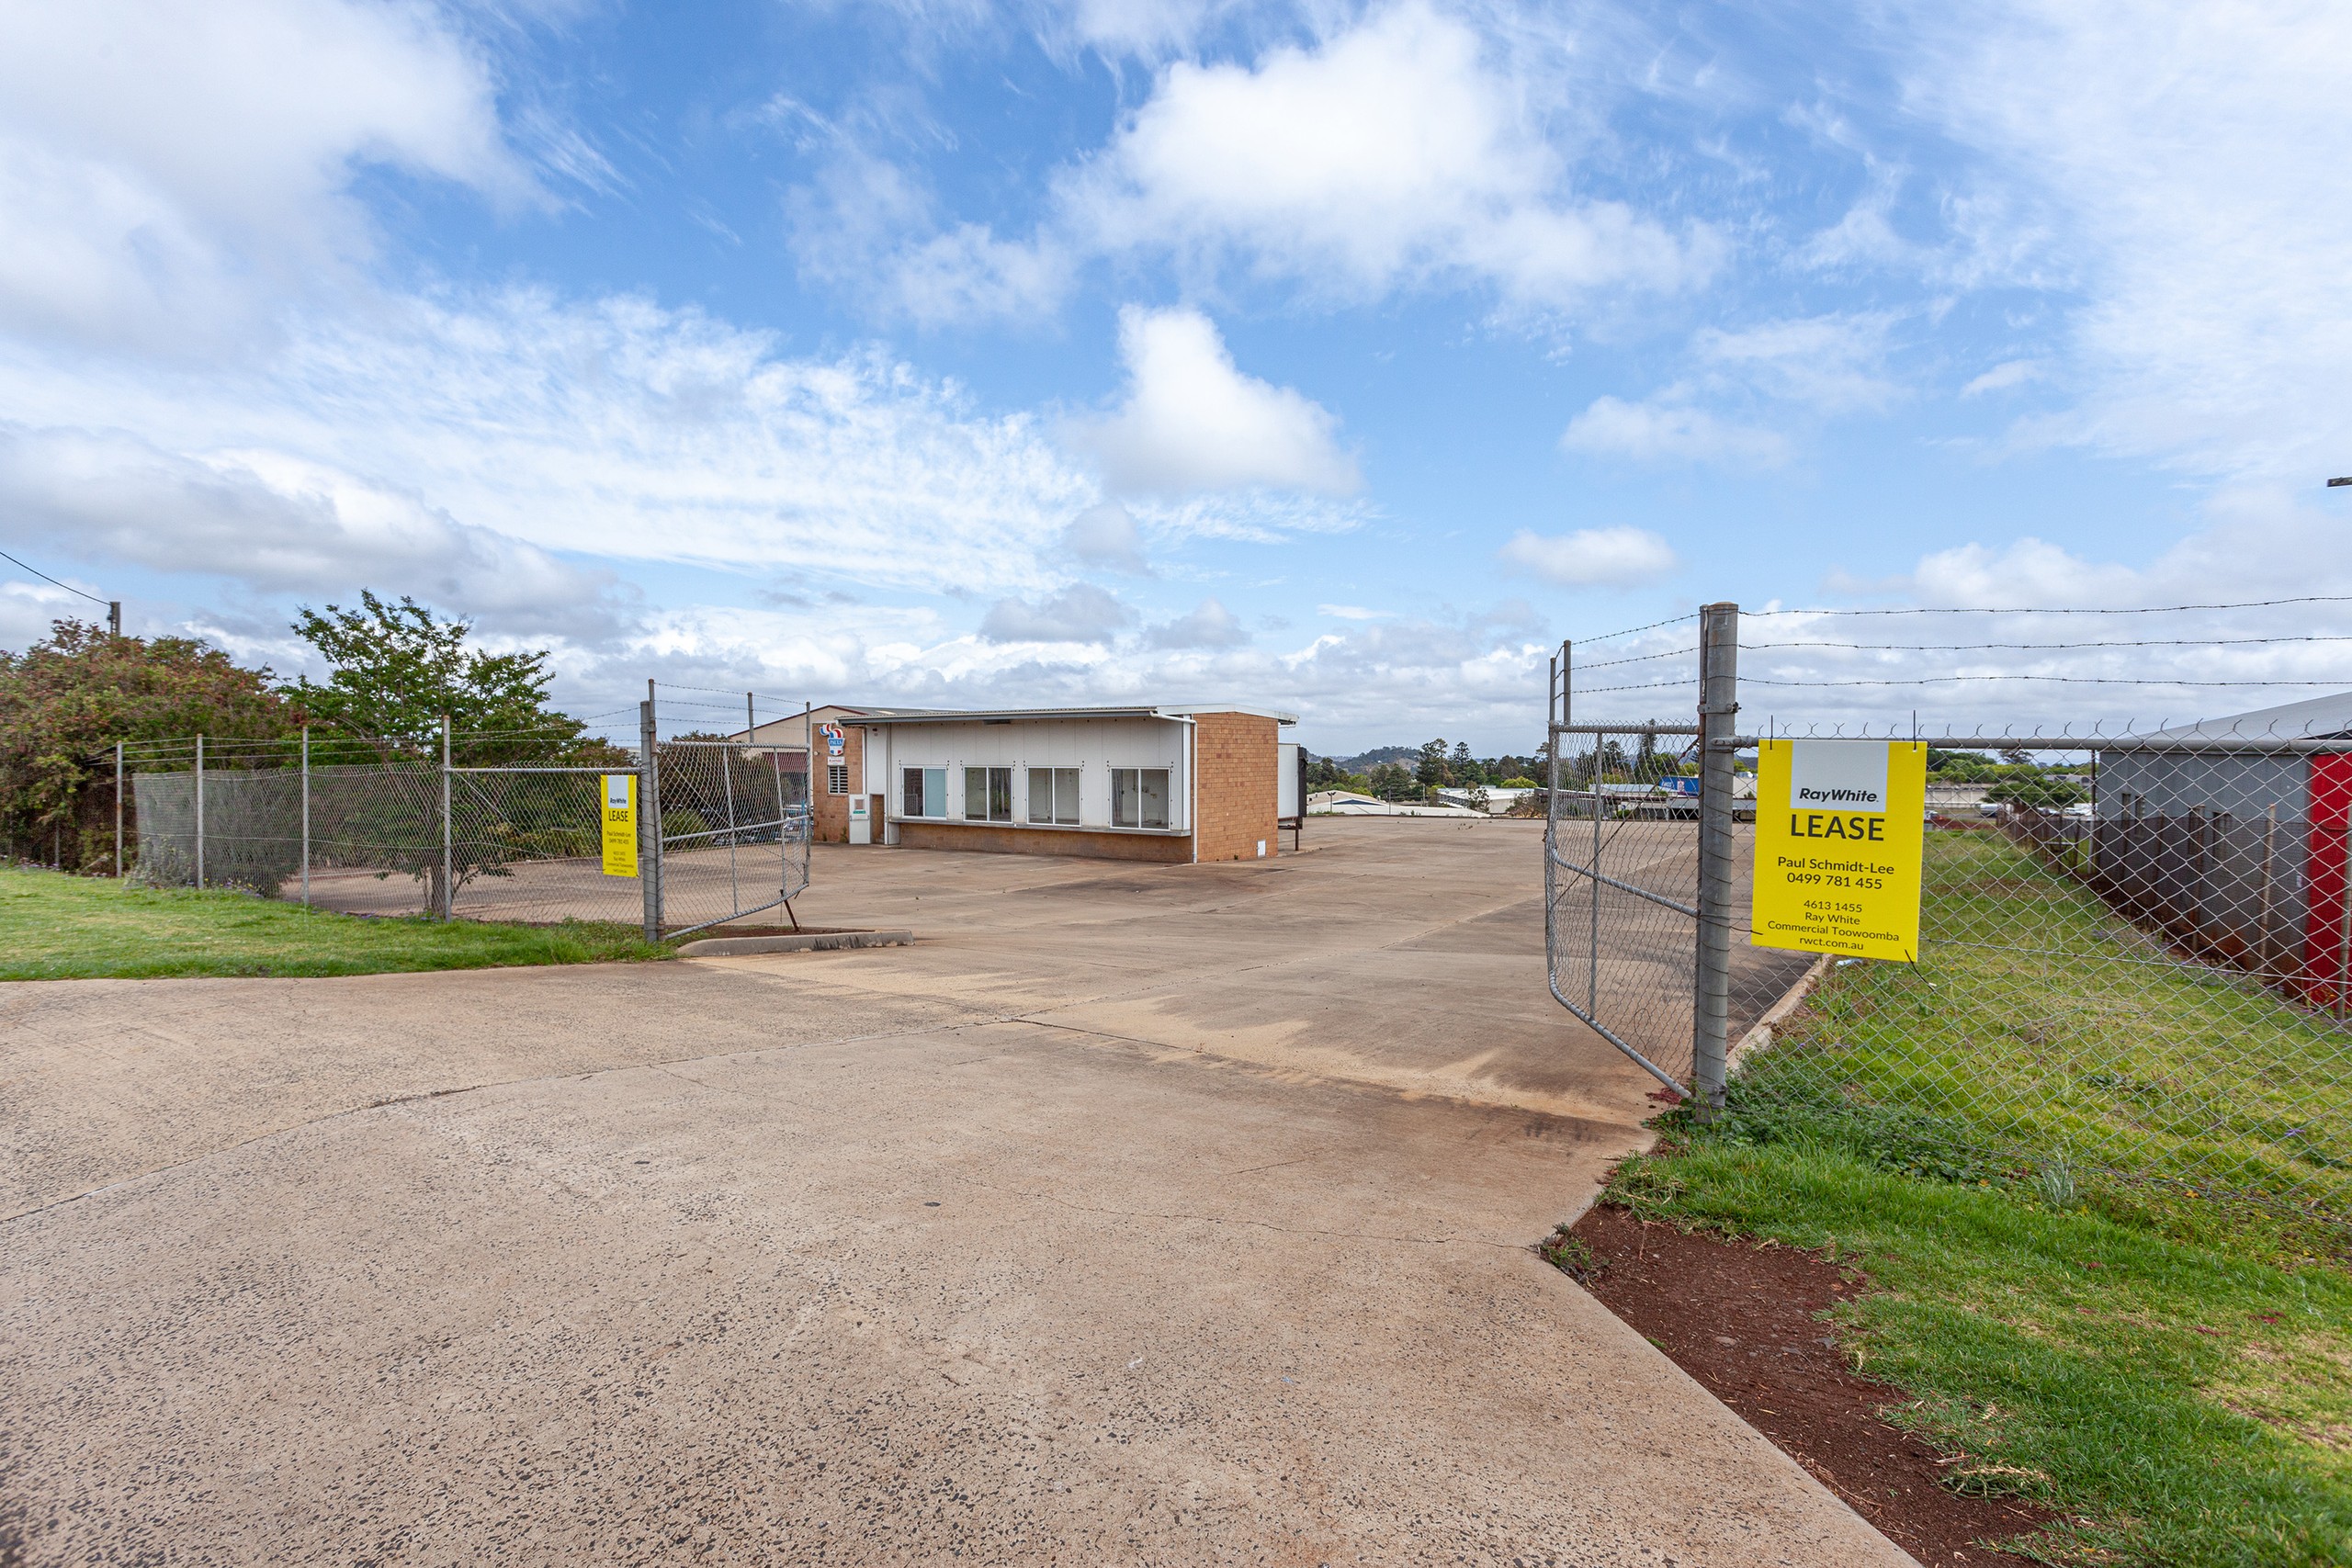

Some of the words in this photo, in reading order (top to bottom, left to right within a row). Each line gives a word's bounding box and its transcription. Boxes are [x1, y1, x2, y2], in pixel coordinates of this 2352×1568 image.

[608, 810, 628, 822] LEASE
[1791, 814, 1885, 841] LEASE
[1778, 856, 1805, 869] Paul
[1809, 858, 1894, 874] Schmidt-Lee
[1787, 873, 1821, 885] 0499
[1826, 875, 1851, 887] 781
[1855, 877, 1883, 889] 455
[1804, 899, 1831, 910] 4613
[1835, 902, 1862, 913] 1455
[1805, 911, 1825, 923] Ray
[1827, 913, 1860, 925] White
[1768, 920, 1828, 935] Commercial
[1832, 926, 1900, 942] Toowoomba
[1799, 937, 1864, 951] rwct.com.au
